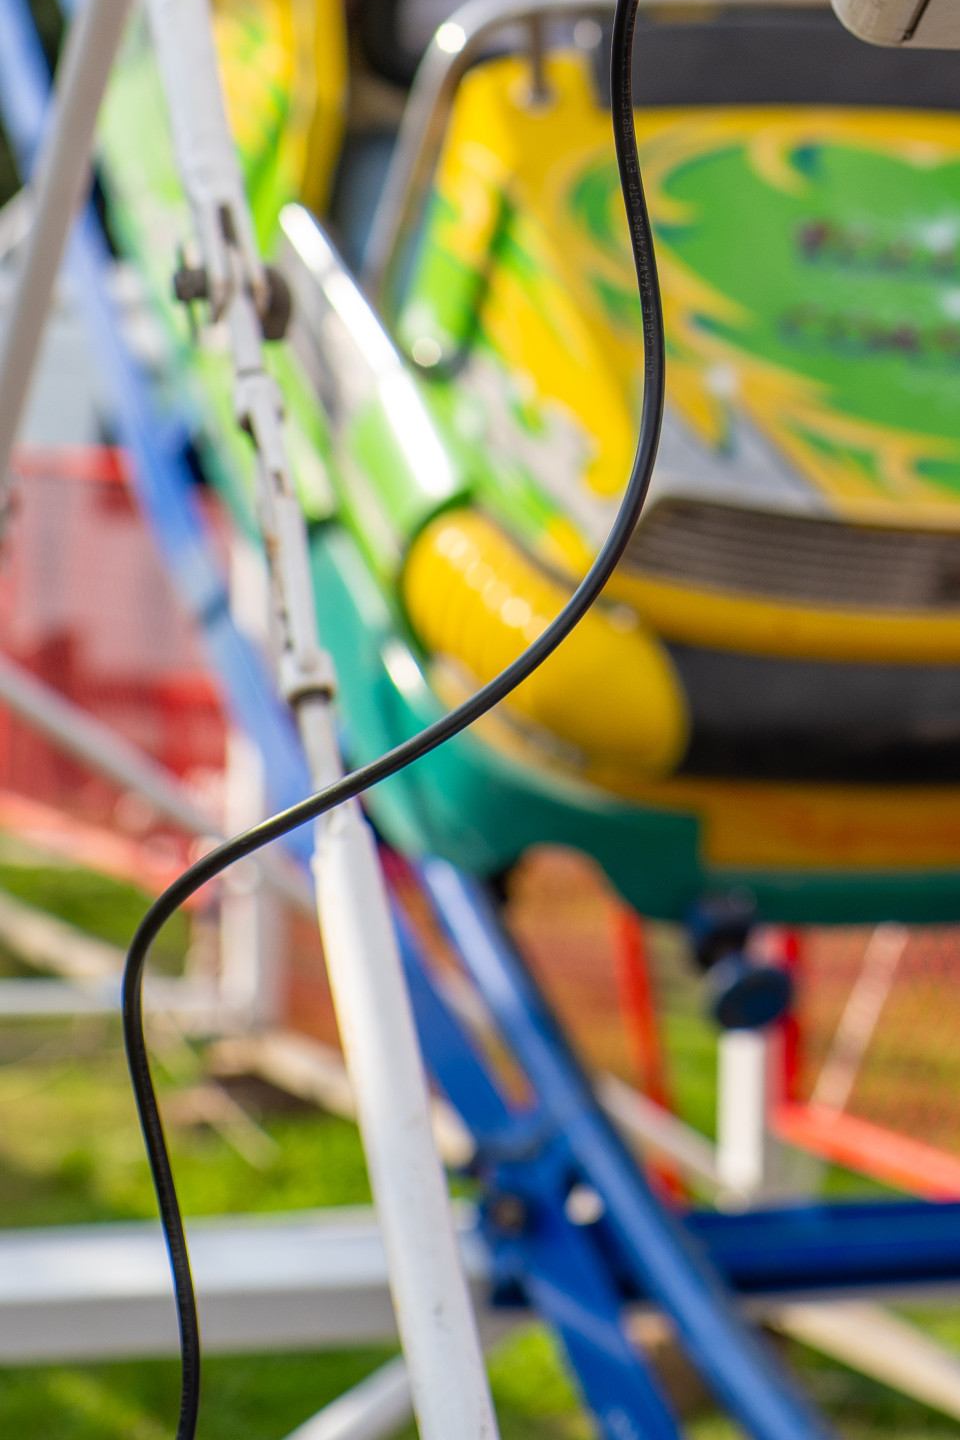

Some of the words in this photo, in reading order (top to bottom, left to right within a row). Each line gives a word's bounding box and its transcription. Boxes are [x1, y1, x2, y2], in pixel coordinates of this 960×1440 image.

[621, 77, 633, 140] VERIFIED
[623, 149, 637, 173] ETL
[628, 182, 641, 207] UTP
[632, 215, 653, 296] 24AWG/4PRS
[643, 305, 655, 345] CABLE
[644, 355, 655, 379] LAN
